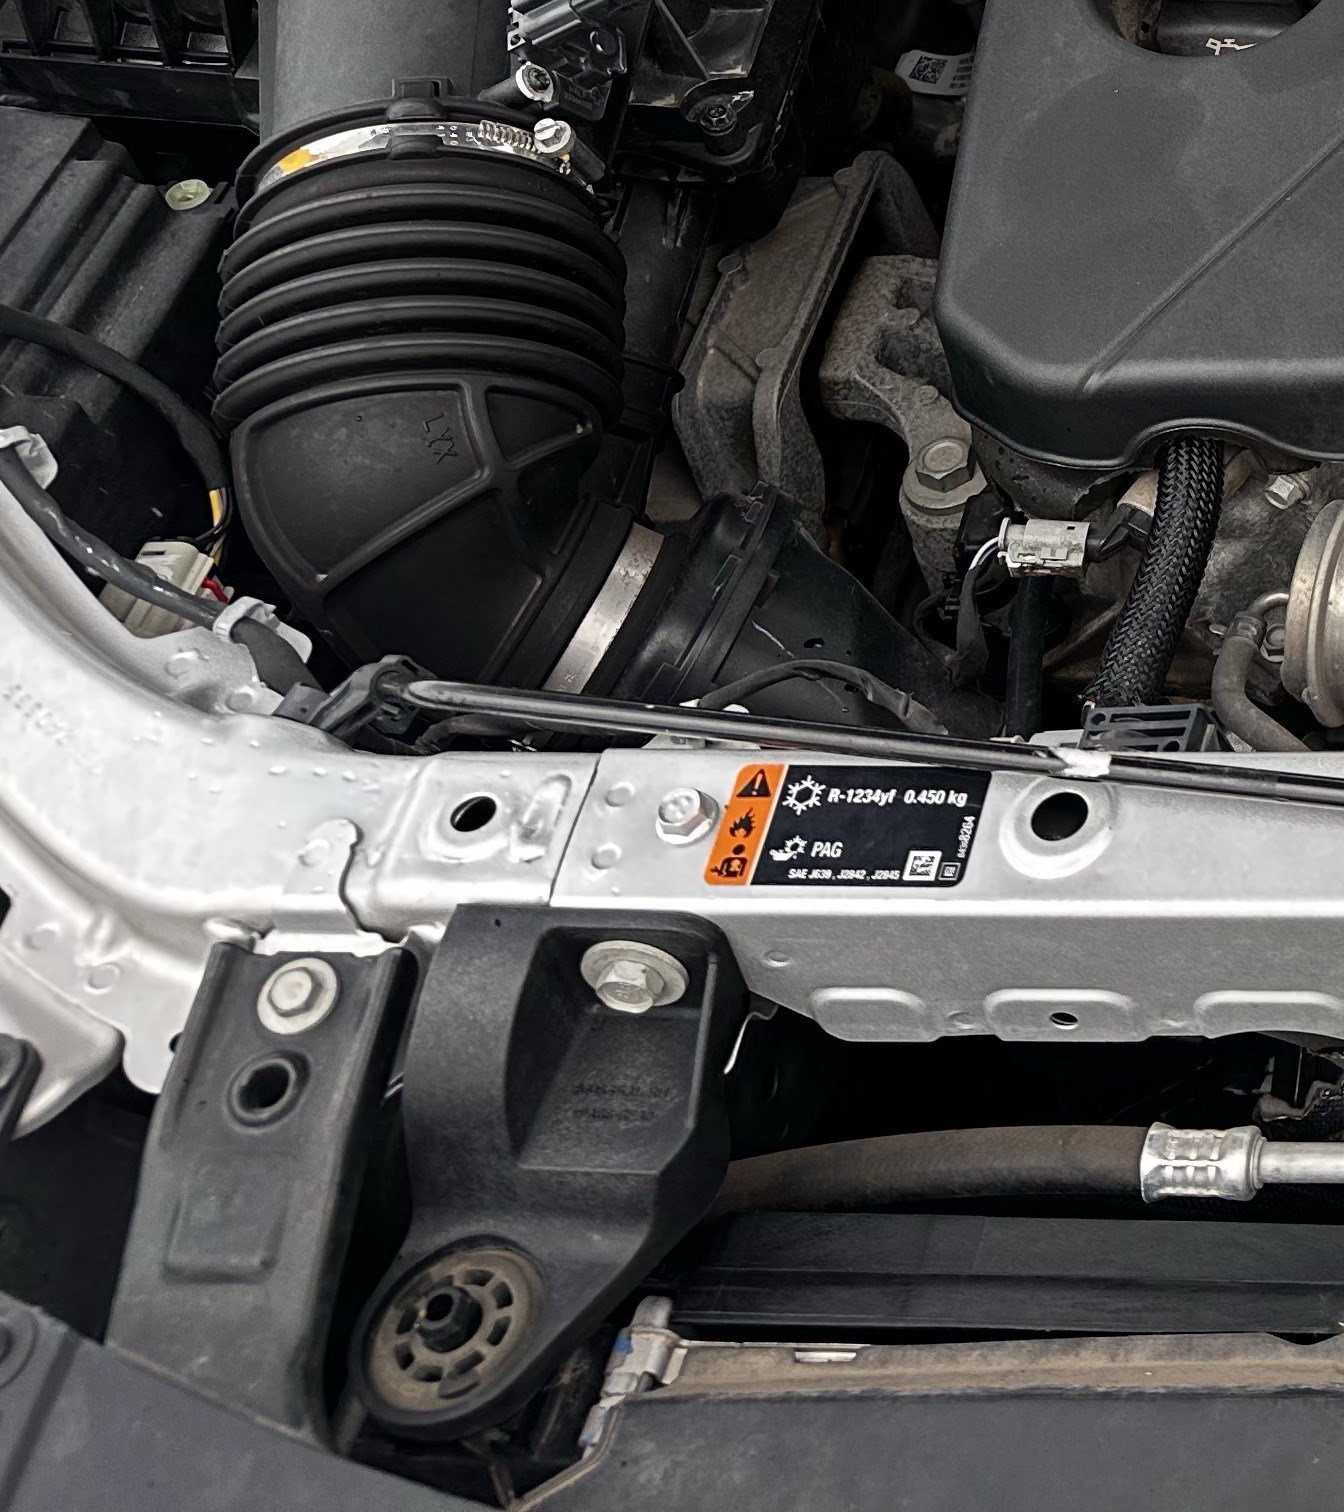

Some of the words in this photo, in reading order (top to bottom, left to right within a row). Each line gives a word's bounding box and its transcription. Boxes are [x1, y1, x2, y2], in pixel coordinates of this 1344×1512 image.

[827, 788, 897, 807] R-1234yf
[903, 789, 946, 805] 0.450
[947, 789, 968, 808] kg
[810, 841, 844, 858] PAG
[788, 868, 808, 879] SAE
